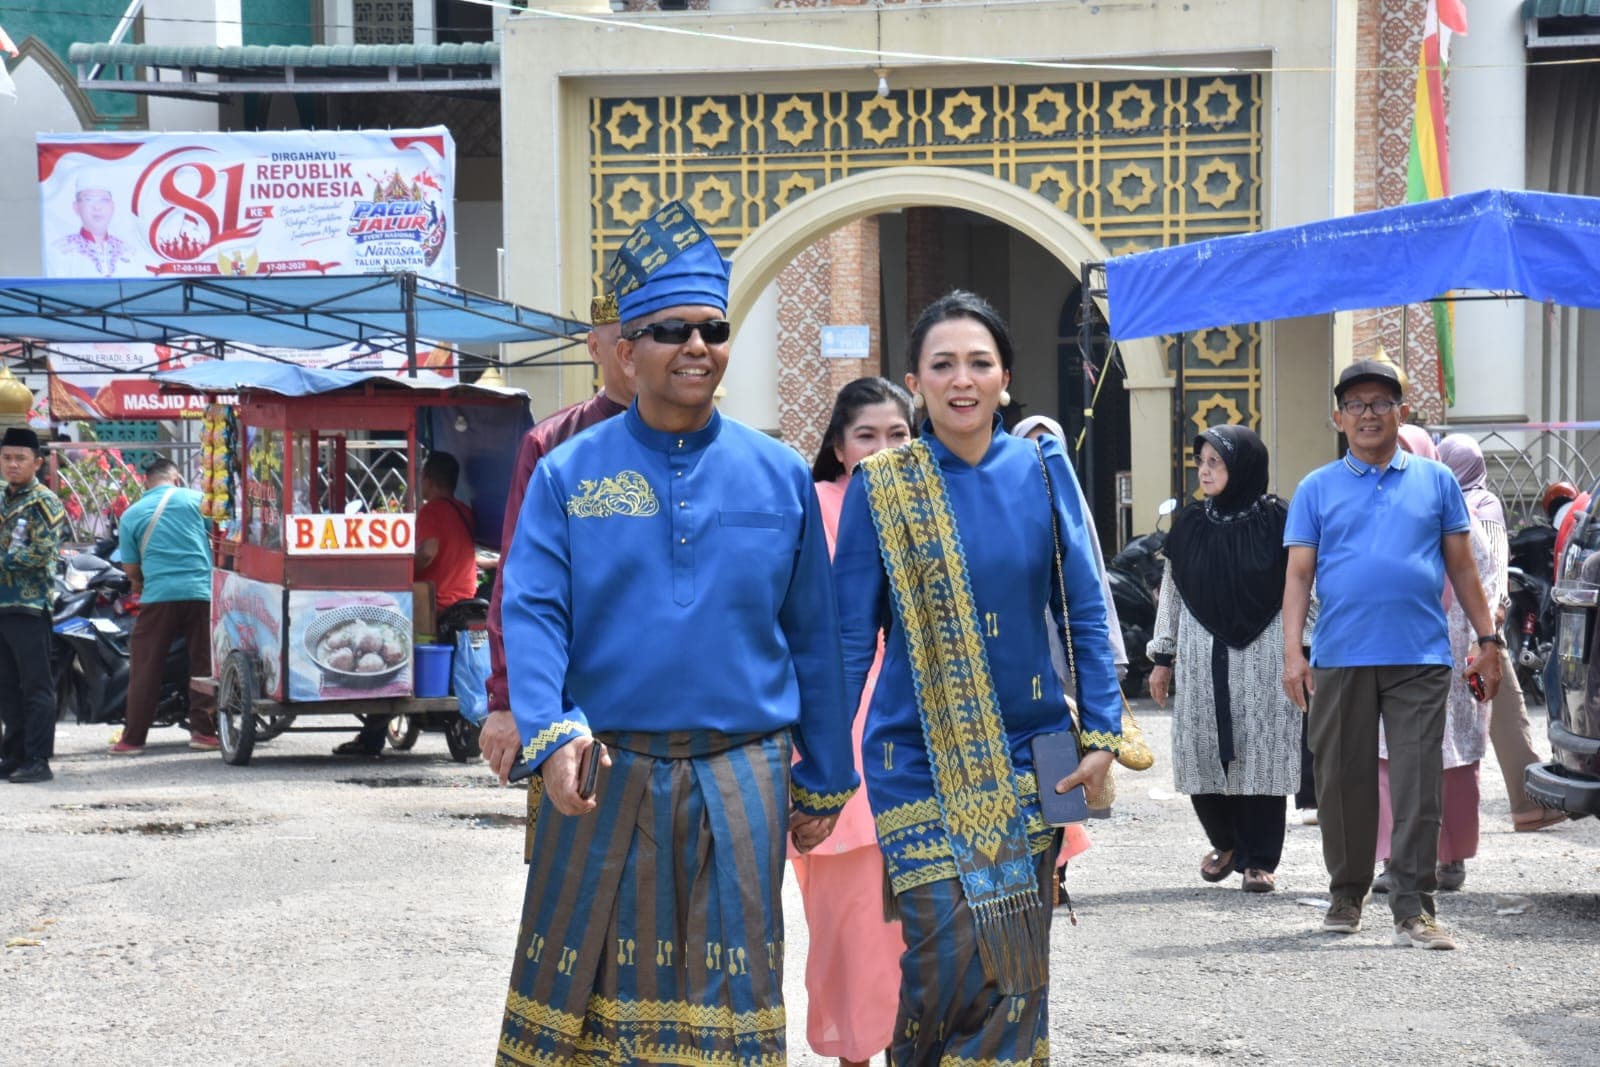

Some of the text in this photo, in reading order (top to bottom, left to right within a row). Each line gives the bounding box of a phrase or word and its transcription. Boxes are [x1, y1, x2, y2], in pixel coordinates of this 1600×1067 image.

[271, 151, 337, 162] DIRGAHAYU
[257, 162, 353, 180] REPUBLIK
[250, 180, 364, 199] INDONESIA
[148, 162, 250, 261] 81
[354, 202, 420, 218] PACU
[350, 217, 427, 233] JALUR
[384, 257, 423, 265] KUANTAN
[123, 394, 185, 411] MASJID
[294, 517, 411, 550] BAKSO
